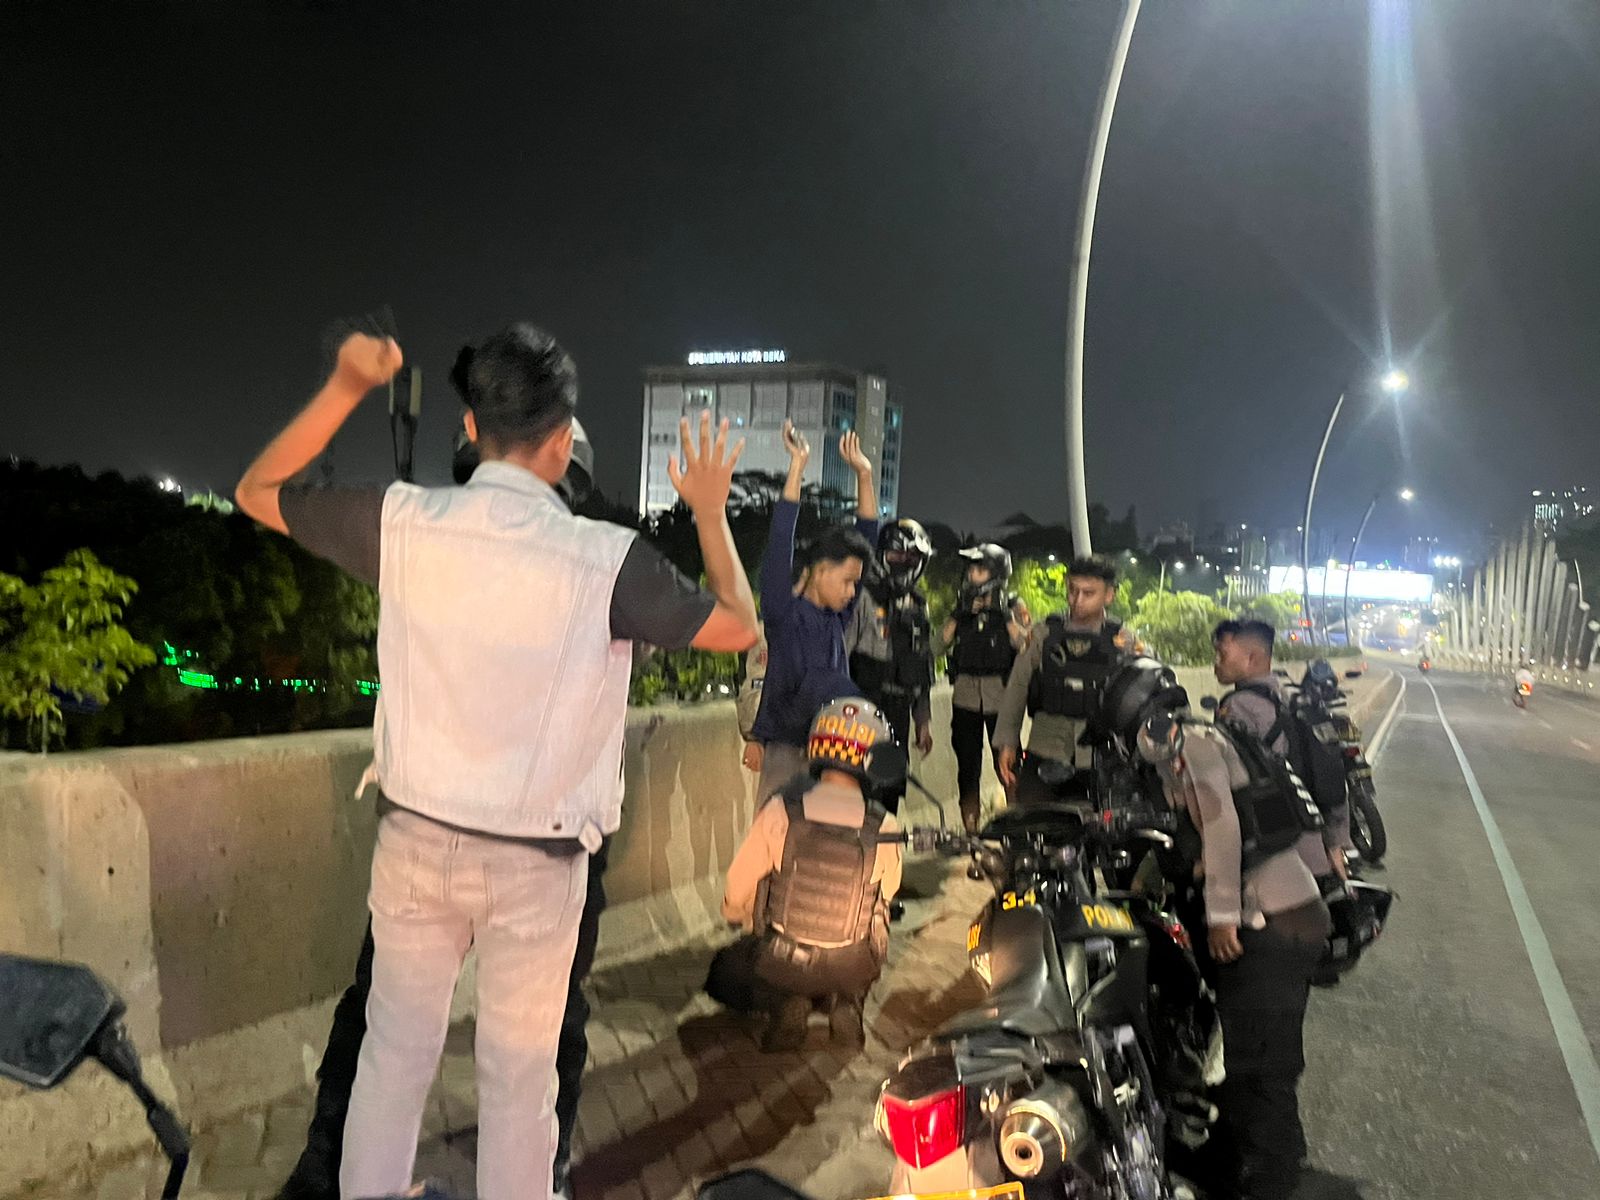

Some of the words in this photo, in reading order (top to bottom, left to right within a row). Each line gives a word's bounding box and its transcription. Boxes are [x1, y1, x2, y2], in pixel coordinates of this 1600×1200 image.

[741, 350, 762, 363] KOTA
[815, 714, 877, 748] POLISI
[1002, 891, 1036, 911] 3.4
